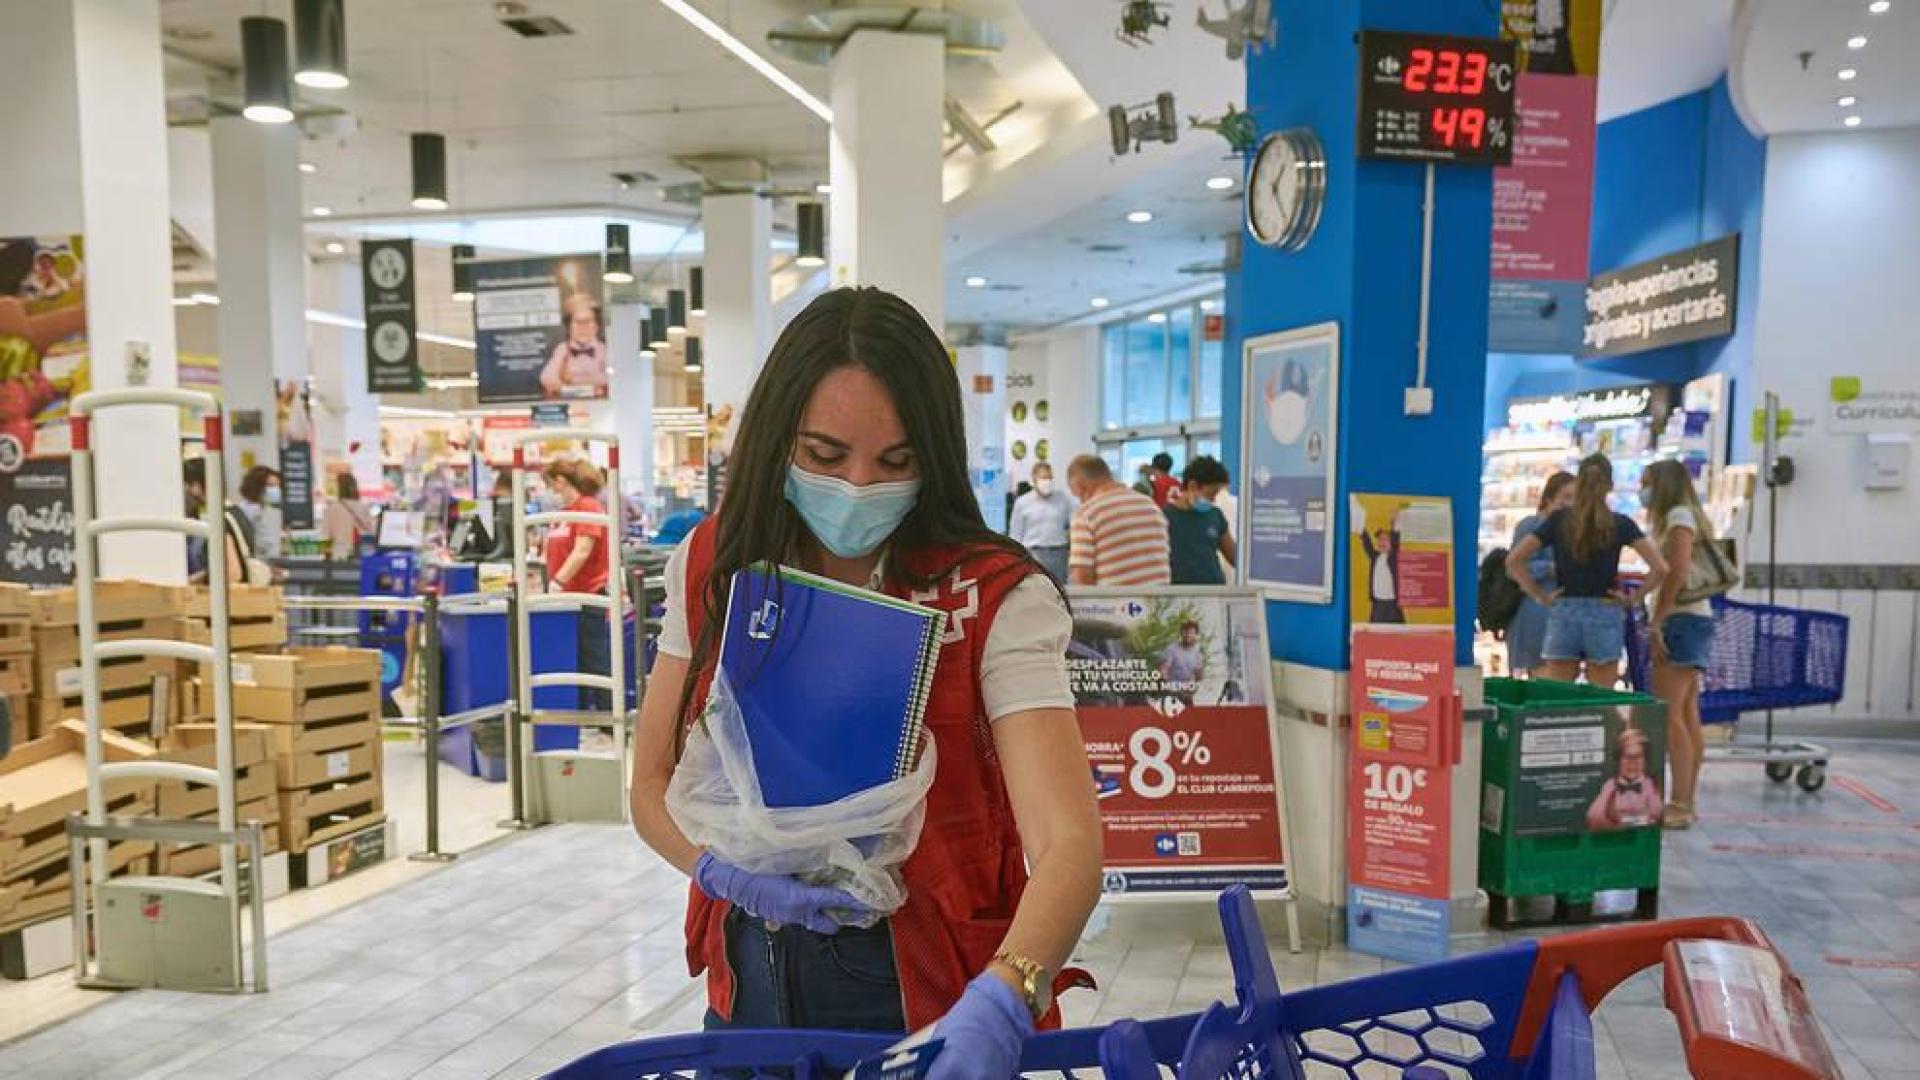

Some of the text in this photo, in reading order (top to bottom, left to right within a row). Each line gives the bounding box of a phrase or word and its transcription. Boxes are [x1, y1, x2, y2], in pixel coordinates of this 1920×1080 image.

[1432, 108, 1485, 147] 49
[1487, 117, 1506, 147] %
[1626, 259, 1717, 306] experiencias
[1652, 288, 1726, 331] acertarás
[1082, 670, 1100, 680] TU
[1082, 681, 1098, 691] VA
[1100, 681, 1111, 691] A
[1113, 681, 1158, 692] COSTAR
[1161, 681, 1196, 692] MENO
[1129, 727, 1211, 798] 8%
[1364, 762, 1427, 801] 10€
[1177, 784, 1189, 793] EL
[1190, 784, 1215, 793] CLUB
[1380, 801, 1425, 816] REGALO
